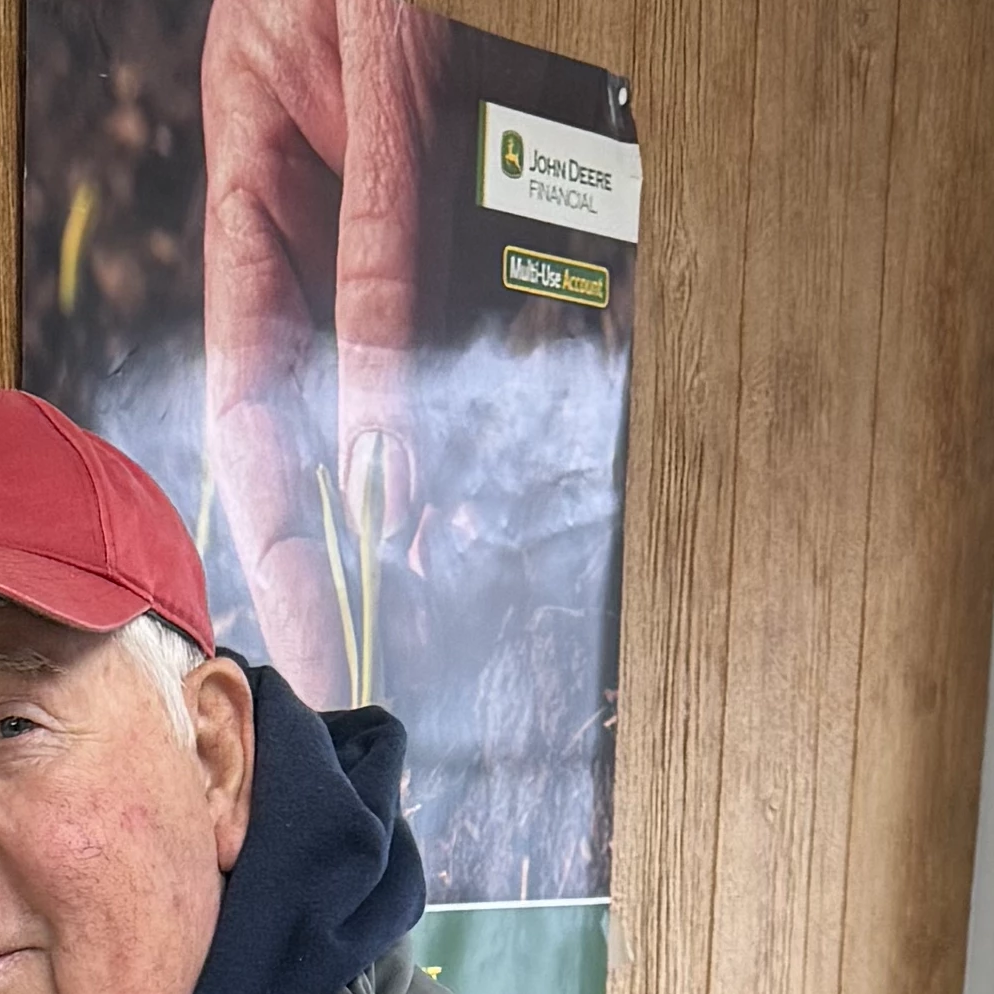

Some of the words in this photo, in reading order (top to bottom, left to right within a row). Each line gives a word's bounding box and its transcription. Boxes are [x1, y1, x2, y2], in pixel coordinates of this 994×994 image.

[529, 149, 566, 180] JOHN
[569, 158, 612, 191] DEERE
[529, 179, 598, 214] FINANCIAL
[510, 255, 561, 288] Multi-Use
[563, 269, 603, 298] Account
